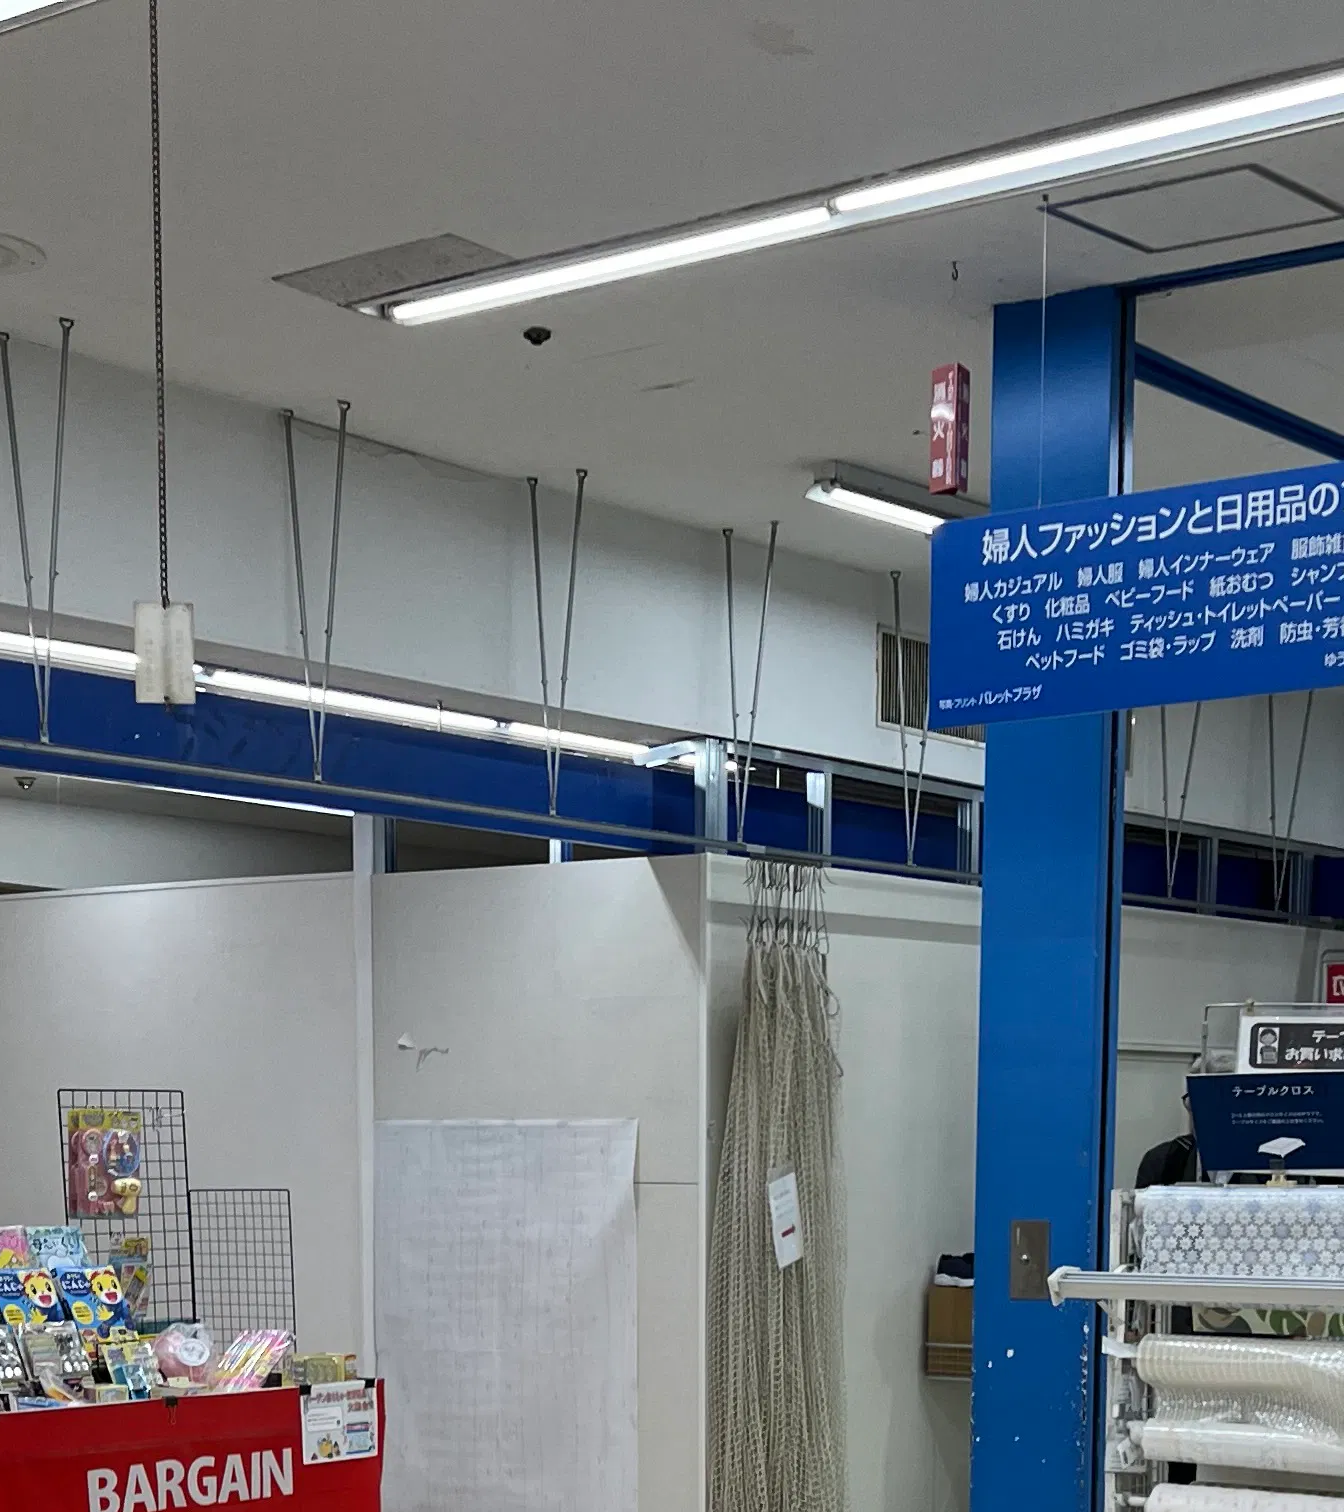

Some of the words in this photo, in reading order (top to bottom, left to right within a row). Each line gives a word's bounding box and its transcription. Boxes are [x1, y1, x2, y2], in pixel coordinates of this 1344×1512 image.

[964, 572, 1063, 603] 婦人カジュアル
[1077, 562, 1124, 588] 婦人服
[1138, 543, 1275, 580] 婦人インナーウェア
[992, 603, 1032, 624] くすり
[1045, 593, 1090, 619] 化粧品
[1105, 580, 1195, 609] ベビーフード
[1209, 572, 1274, 598] 紙おむつ
[997, 627, 1042, 651] 石けん
[1055, 617, 1115, 642] ハミガキ
[1026, 644, 1105, 671] ペットフード
[1230, 625, 1265, 649] 洗剤
[1231, 1085, 1315, 1097] テーブルクロス
